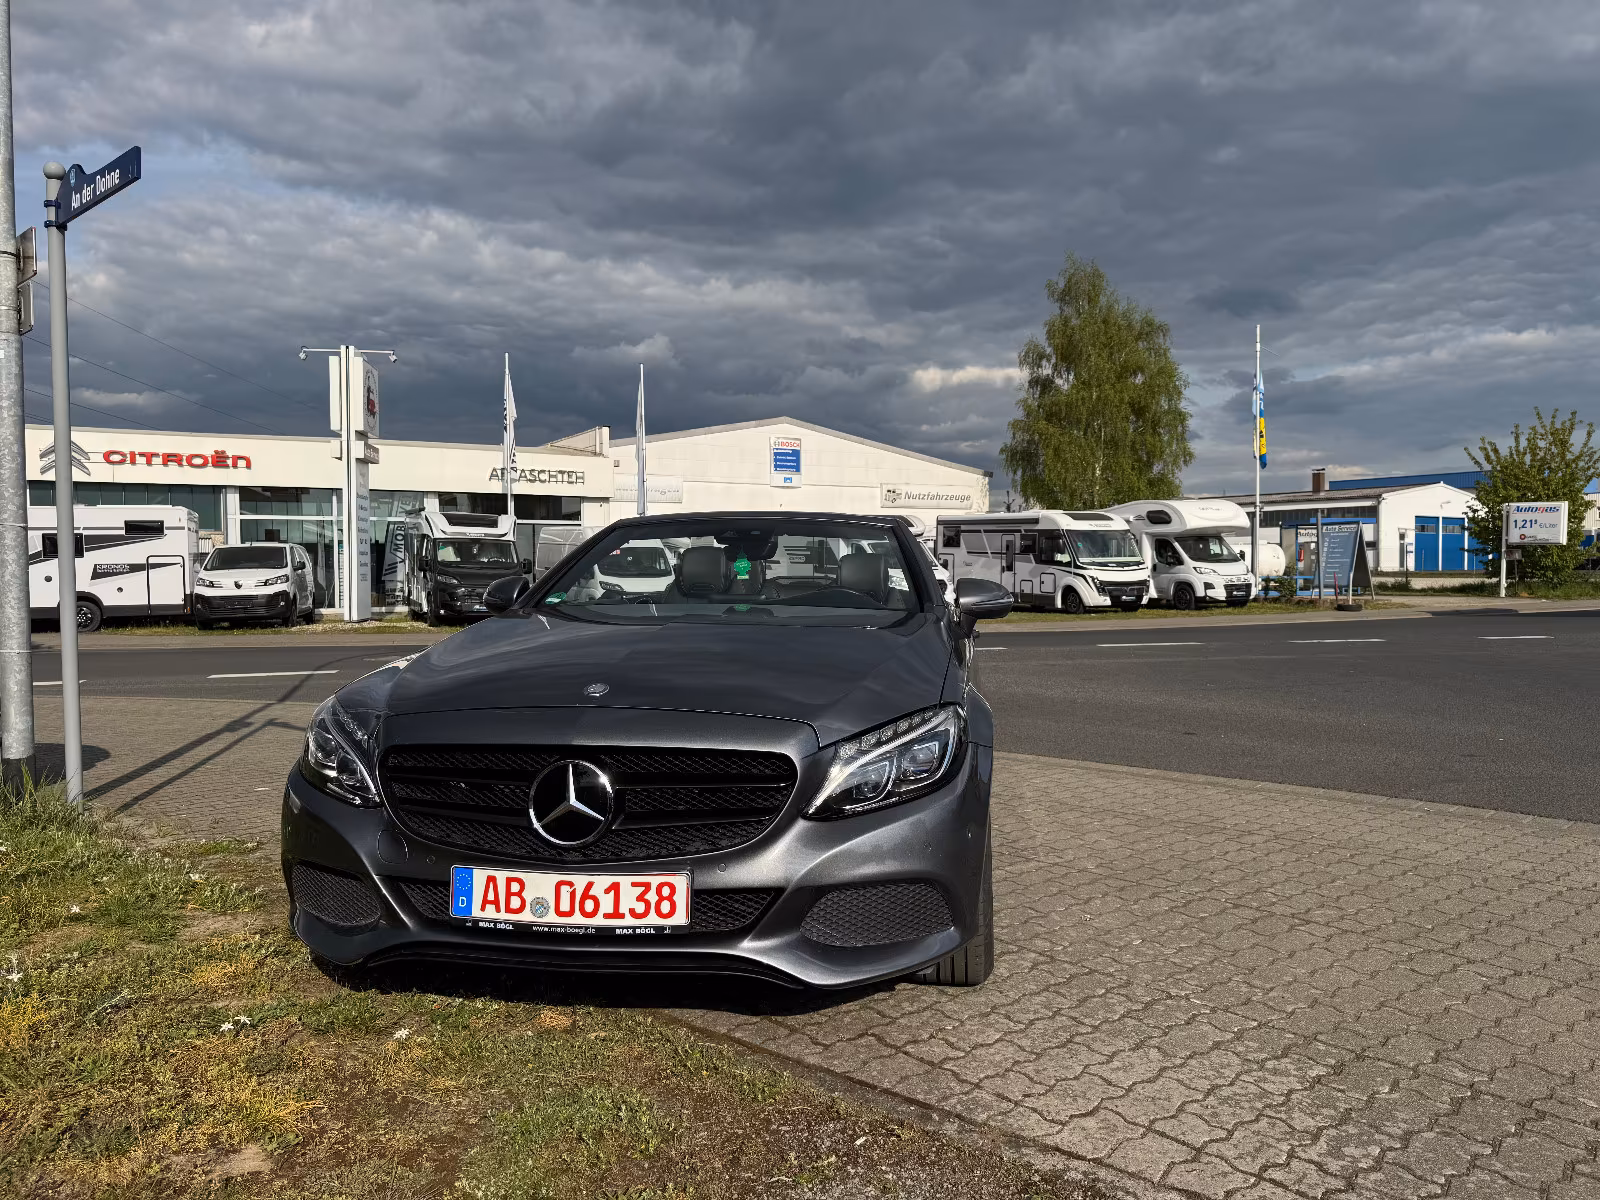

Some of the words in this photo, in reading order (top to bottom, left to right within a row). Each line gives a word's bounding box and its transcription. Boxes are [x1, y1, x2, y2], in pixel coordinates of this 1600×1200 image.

[71, 190, 81, 211] An
[82, 183, 95, 204] der
[96, 168, 120, 195] Dohne
[103, 449, 252, 469] CITROËN
[904, 490, 971, 502] Nutzfahrzeuge
[1513, 505, 1560, 513] Autogas
[458, 897, 467, 908] D
[480, 875, 527, 914] AB
[554, 880, 677, 920] 06138
[478, 921, 495, 929] MAX
[496, 922, 515, 930] BÖGL
[532, 925, 596, 934] www.max-boegl.de
[635, 926, 655, 934] BÖGL
